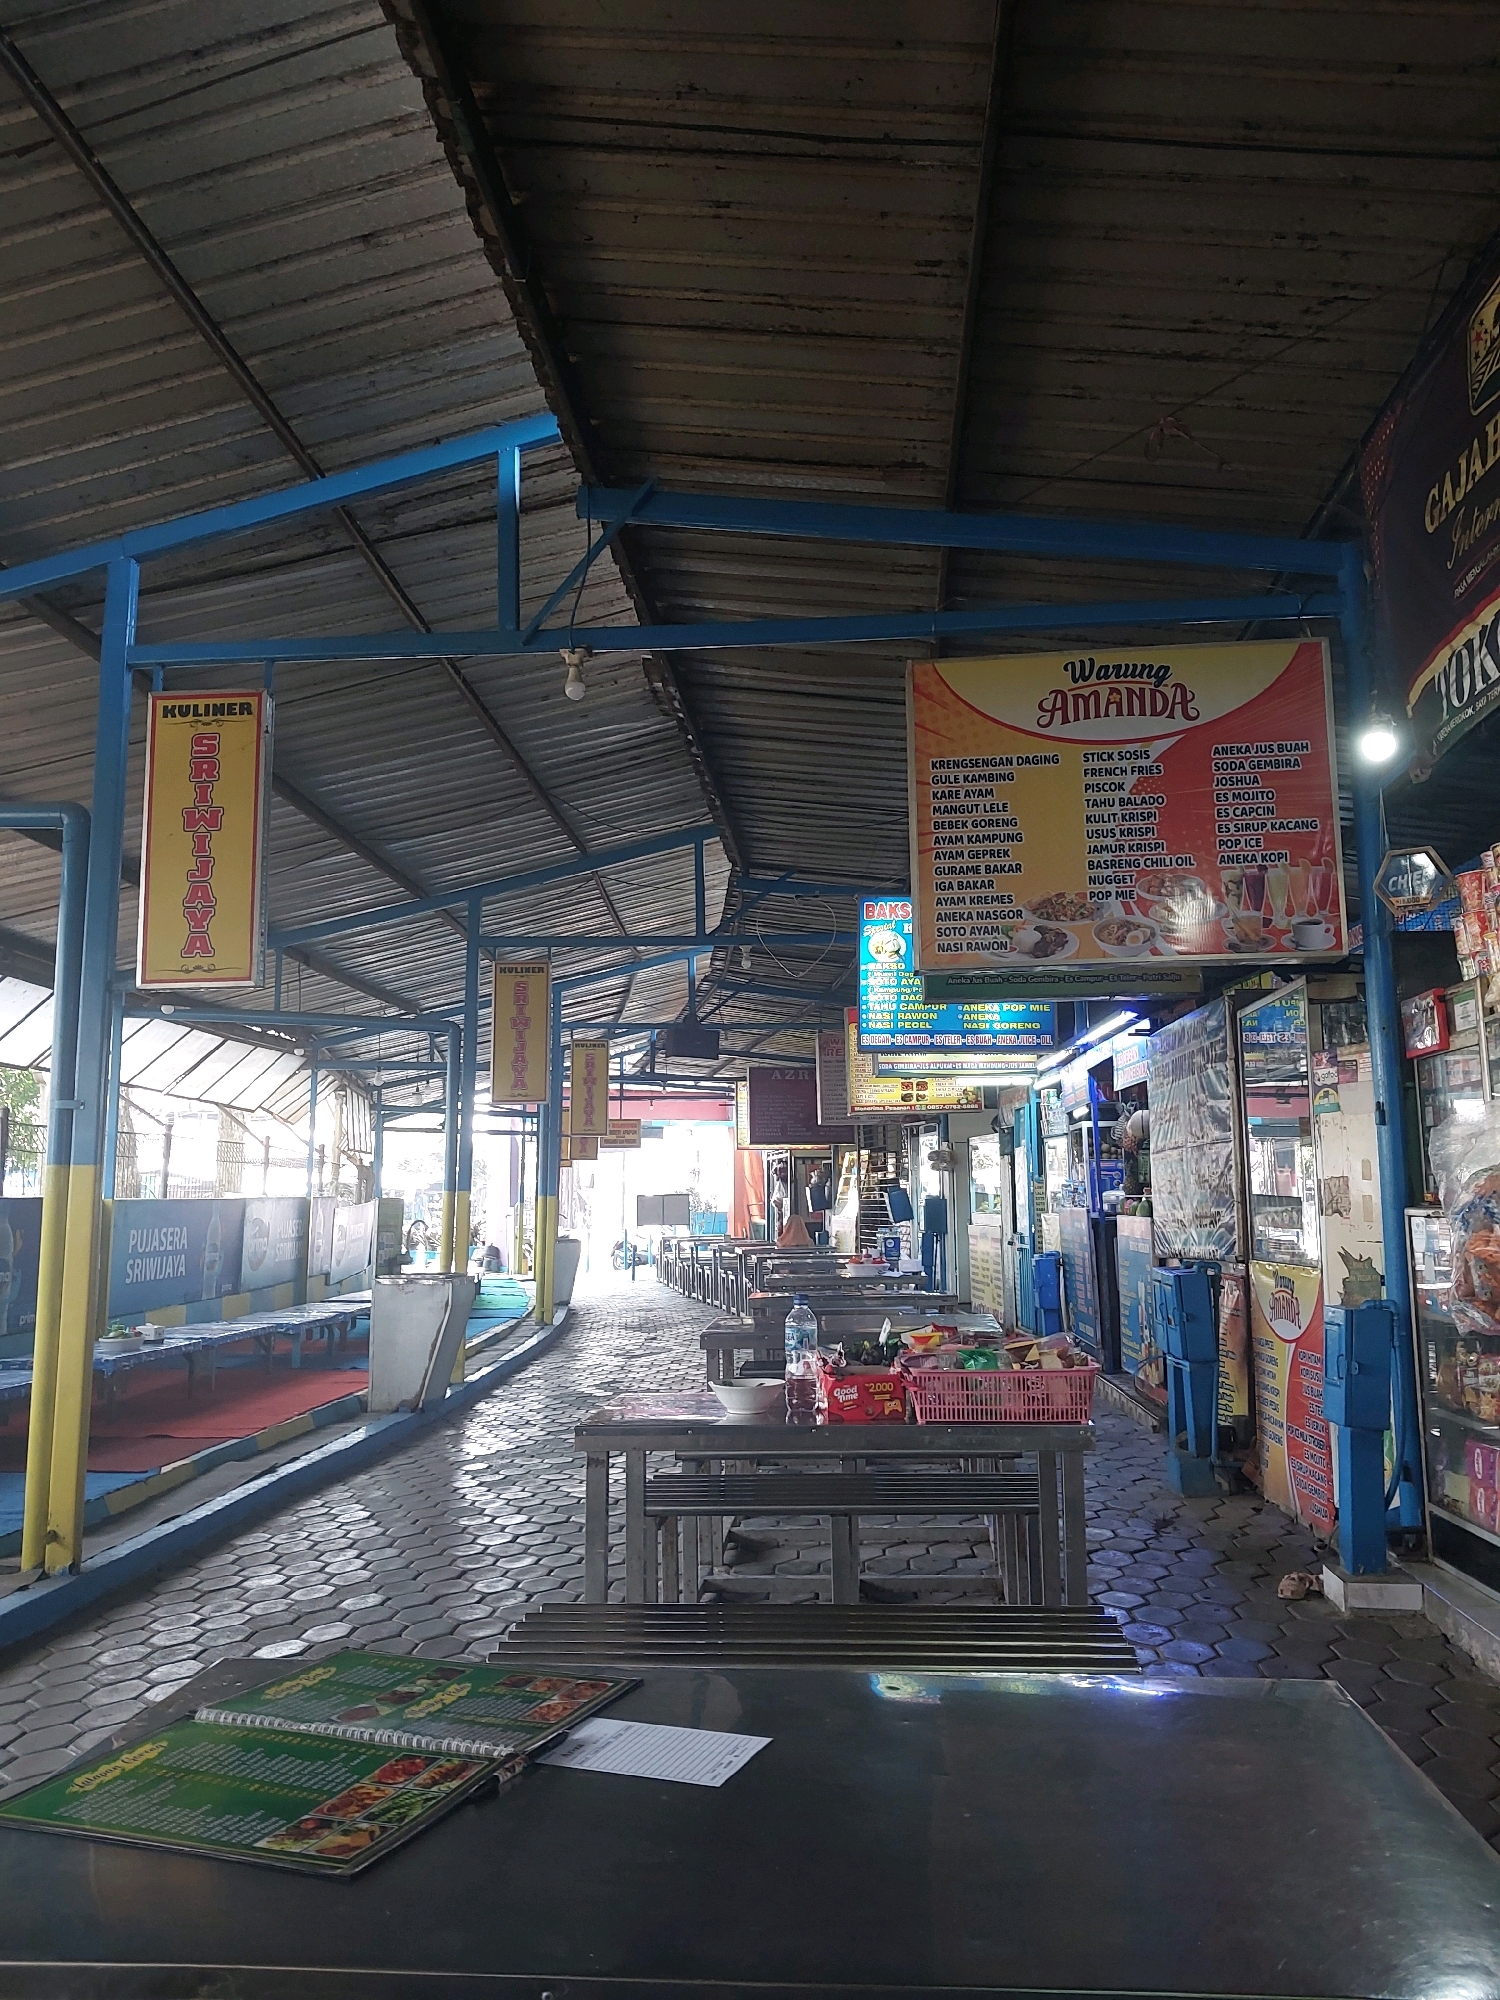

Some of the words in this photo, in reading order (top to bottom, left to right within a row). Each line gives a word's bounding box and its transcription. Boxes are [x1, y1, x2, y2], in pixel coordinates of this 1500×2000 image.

[1063, 657, 1173, 688] Warung
[162, 701, 253, 719] KULINER
[1037, 682, 1200, 728] AMANDA
[1213, 745, 1251, 756] ANEKA
[1254, 744, 1274, 754] JUS
[1277, 742, 1308, 752] BUAH
[932, 757, 1013, 770] KRENGSENGAN
[1016, 754, 1059, 766] DAGING
[1083, 752, 1114, 762] STICK
[1118, 750, 1150, 760] SOSIS
[1214, 761, 1245, 772] SODA
[1249, 758, 1300, 770] GEMBIRA
[1084, 766, 1127, 778] FRENCH
[1131, 765, 1162, 776] FRIES
[932, 774, 960, 784] GULE
[963, 772, 1014, 783] KAMBING
[1215, 775, 1260, 786] JOSHUA
[1085, 782, 1125, 793] PISCOK
[932, 790, 961, 800] KARE
[964, 788, 994, 799] AYAM
[1216, 792, 1229, 802] ES
[1232, 790, 1274, 801] MOJITO
[1085, 798, 1115, 808] TAHU
[1119, 795, 1164, 806] BALADO
[933, 804, 980, 815] MANGUT
[984, 802, 1008, 813] LELE
[1217, 808, 1230, 818] ES
[1233, 806, 1274, 817] CAPCIN
[1086, 813, 1118, 824] KULIT
[1121, 811, 1156, 822] KRISPI
[934, 820, 968, 830] BEBEK
[971, 818, 1017, 828] GORENG
[1218, 824, 1230, 833] ES
[1234, 822, 1267, 832] SIRUP
[1271, 820, 1318, 830] KACANG
[1086, 828, 1116, 839] USUS
[1120, 826, 1155, 838] KRISPI
[934, 835, 964, 846] AYAM
[967, 832, 1023, 844] KAMPUNG
[1218, 839, 1241, 849] POP
[1245, 838, 1262, 848] ICE
[181, 733, 224, 958] SRIWIJAYA
[1087, 844, 1125, 854] JAMUR
[1128, 842, 1164, 852] KRISPI
[934, 850, 964, 861] AYAM
[968, 849, 1010, 859] GEPREK
[1219, 854, 1257, 864] ANEKA
[1261, 852, 1288, 862] KOPI
[1088, 858, 1140, 870] BASRENG
[1144, 857, 1172, 868] CHILI
[1176, 856, 1194, 866] OIL
[935, 865, 981, 876] GURAME
[985, 863, 1022, 874] BAKAR
[935, 881, 954, 891] IGA
[957, 880, 994, 890] BAKAR
[1089, 874, 1134, 885] NUGGET
[936, 896, 966, 906] AYAM
[970, 894, 1013, 905] KREMES
[1090, 890, 1112, 900] POP
[1116, 890, 1135, 900] MIE
[936, 912, 973, 922] ANEKA
[977, 910, 1023, 920] NASGOR
[936, 926, 966, 937] SOTO
[970, 926, 999, 936] AYAM
[938, 942, 962, 952] NASI
[967, 941, 1007, 951] RAWON
[499, 966, 545, 974] KULINER
[948, 976, 970, 984] Aneka
[1028, 975, 1058, 983] Gembira
[1074, 975, 1102, 984] Campur
[1110, 974, 1118, 982] Es
[964, 1004, 1000, 1012] ANEKA
[1003, 1004, 1026, 1012] POP
[964, 1022, 989, 1030] NASI
[993, 1022, 1041, 1030] GORENG
[510, 980, 531, 1090] SRIWIJAYA
[861, 1035, 870, 1045] ES
[896, 1035, 903, 1045] ES
[904, 1035, 930, 1045] CAMPUR
[935, 1035, 943, 1045] ES
[944, 1035, 961, 1045] TELER
[967, 1035, 975, 1045] ES
[976, 1035, 992, 1045] BUAH
[997, 1035, 1017, 1045] ANEKA
[1018, 1035, 1036, 1045] JUICE
[129, 1226, 187, 1253] PUJASERA
[126, 1254, 186, 1284] SRIWIJAYA
[834, 1385, 858, 1397] Good
[838, 1393, 858, 1404] Time
